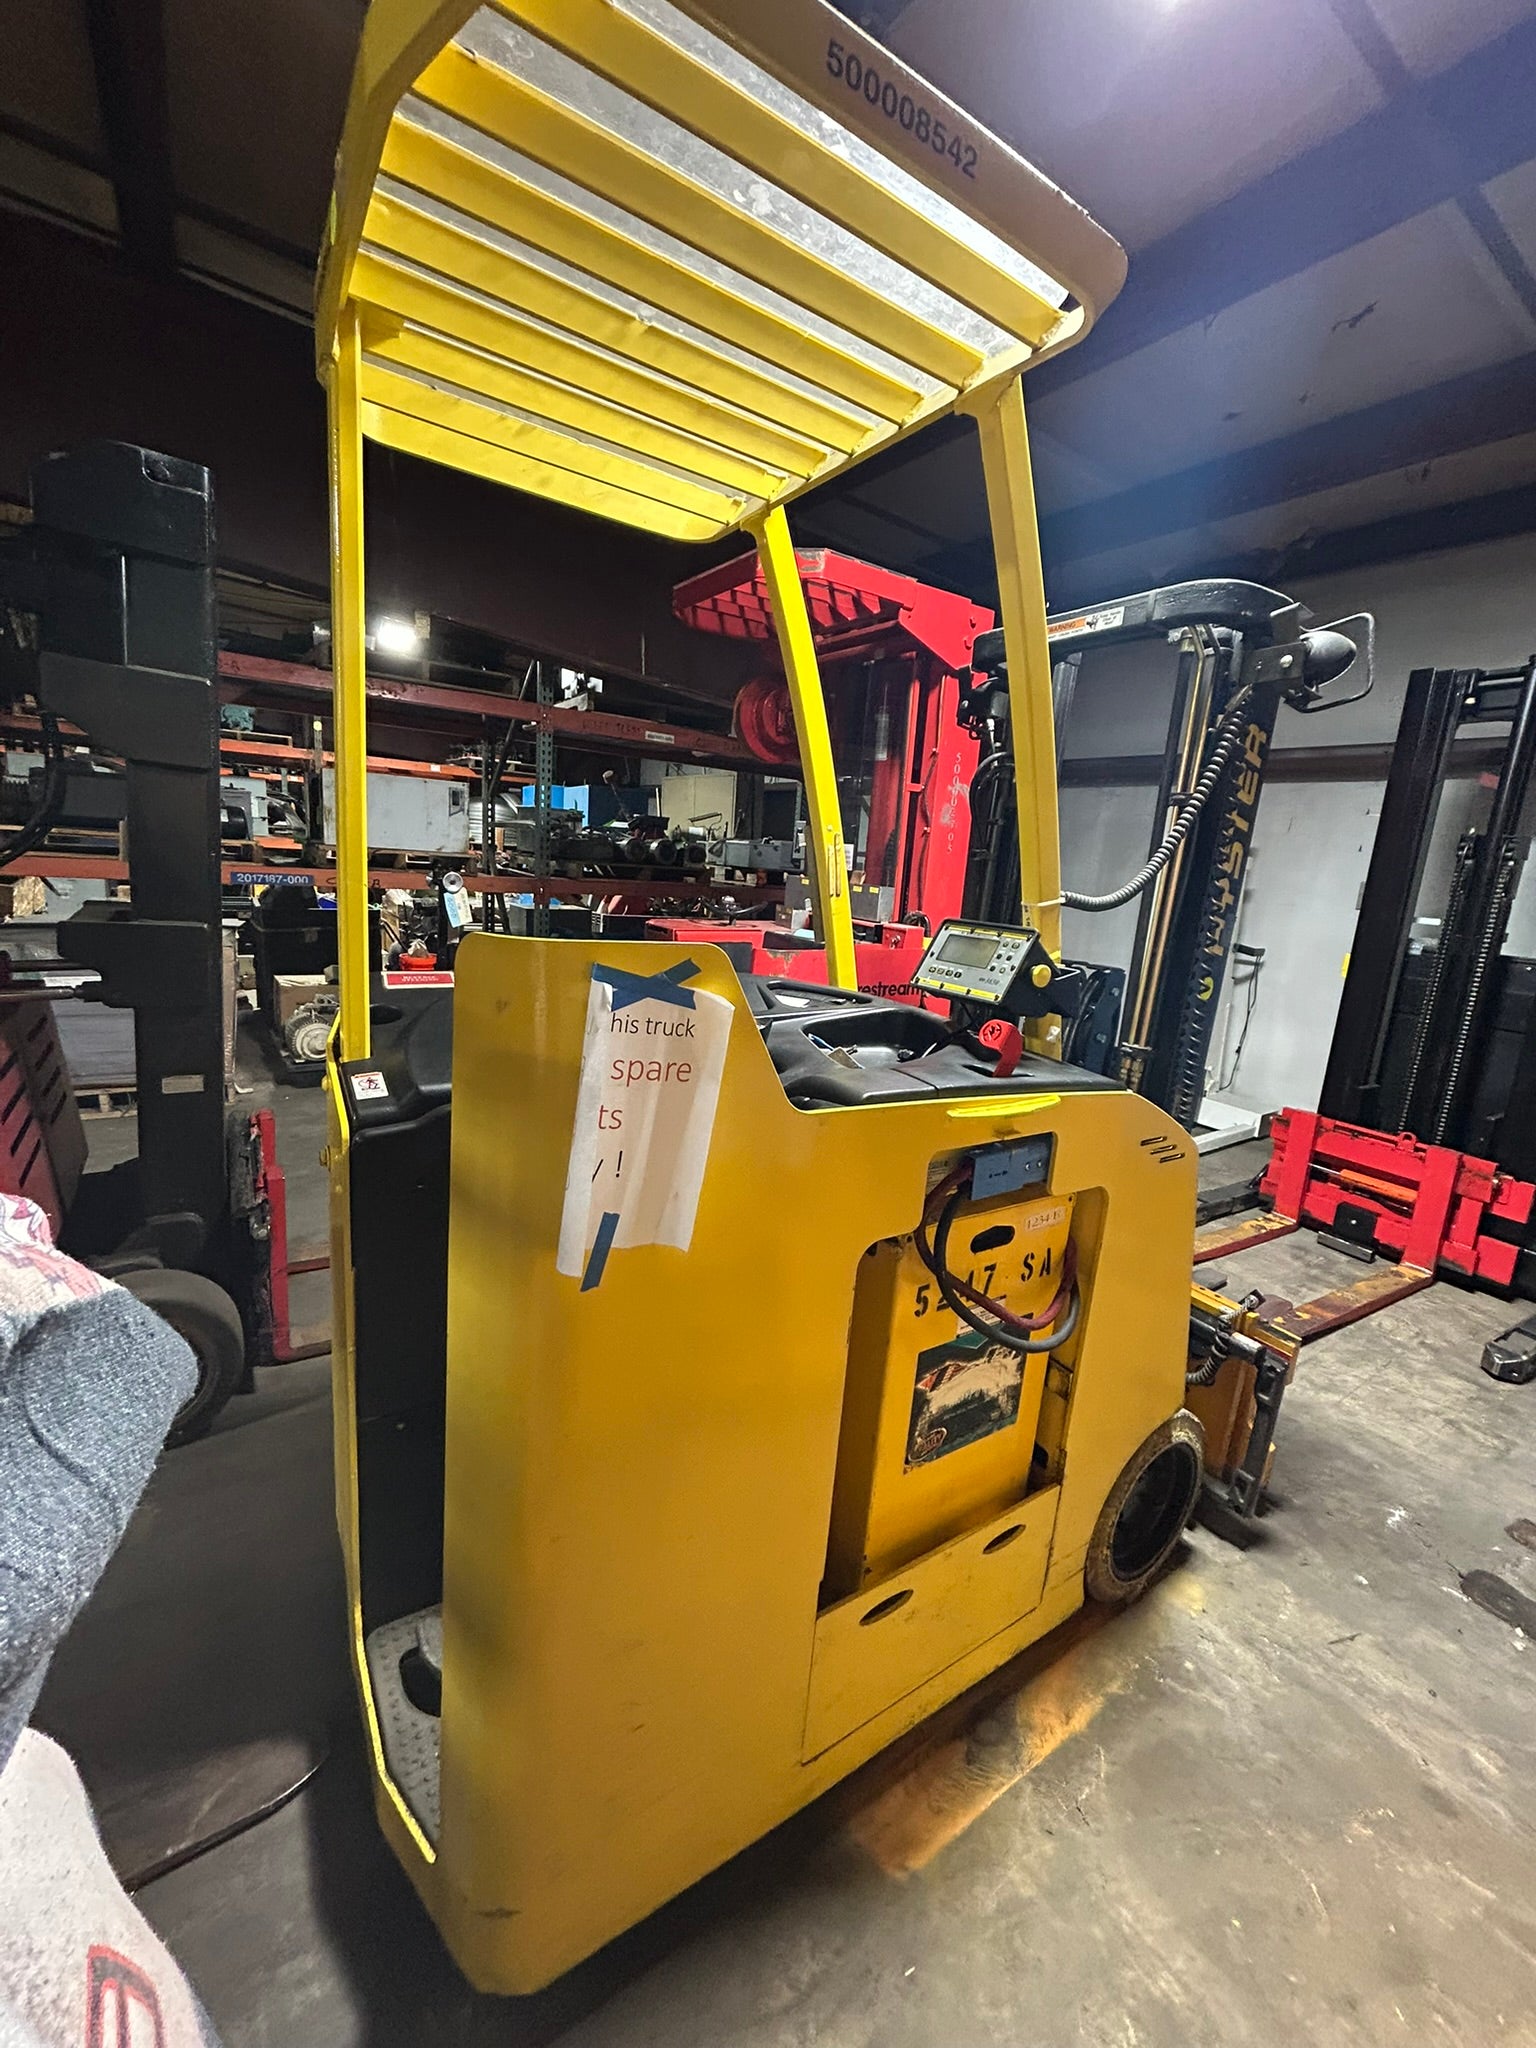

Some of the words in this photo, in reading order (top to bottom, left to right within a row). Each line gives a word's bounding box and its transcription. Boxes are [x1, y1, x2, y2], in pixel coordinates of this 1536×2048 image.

[827, 38, 978, 179] 500008542
[645, 1016, 696, 1038] truck
[610, 1058, 693, 1088] spare
